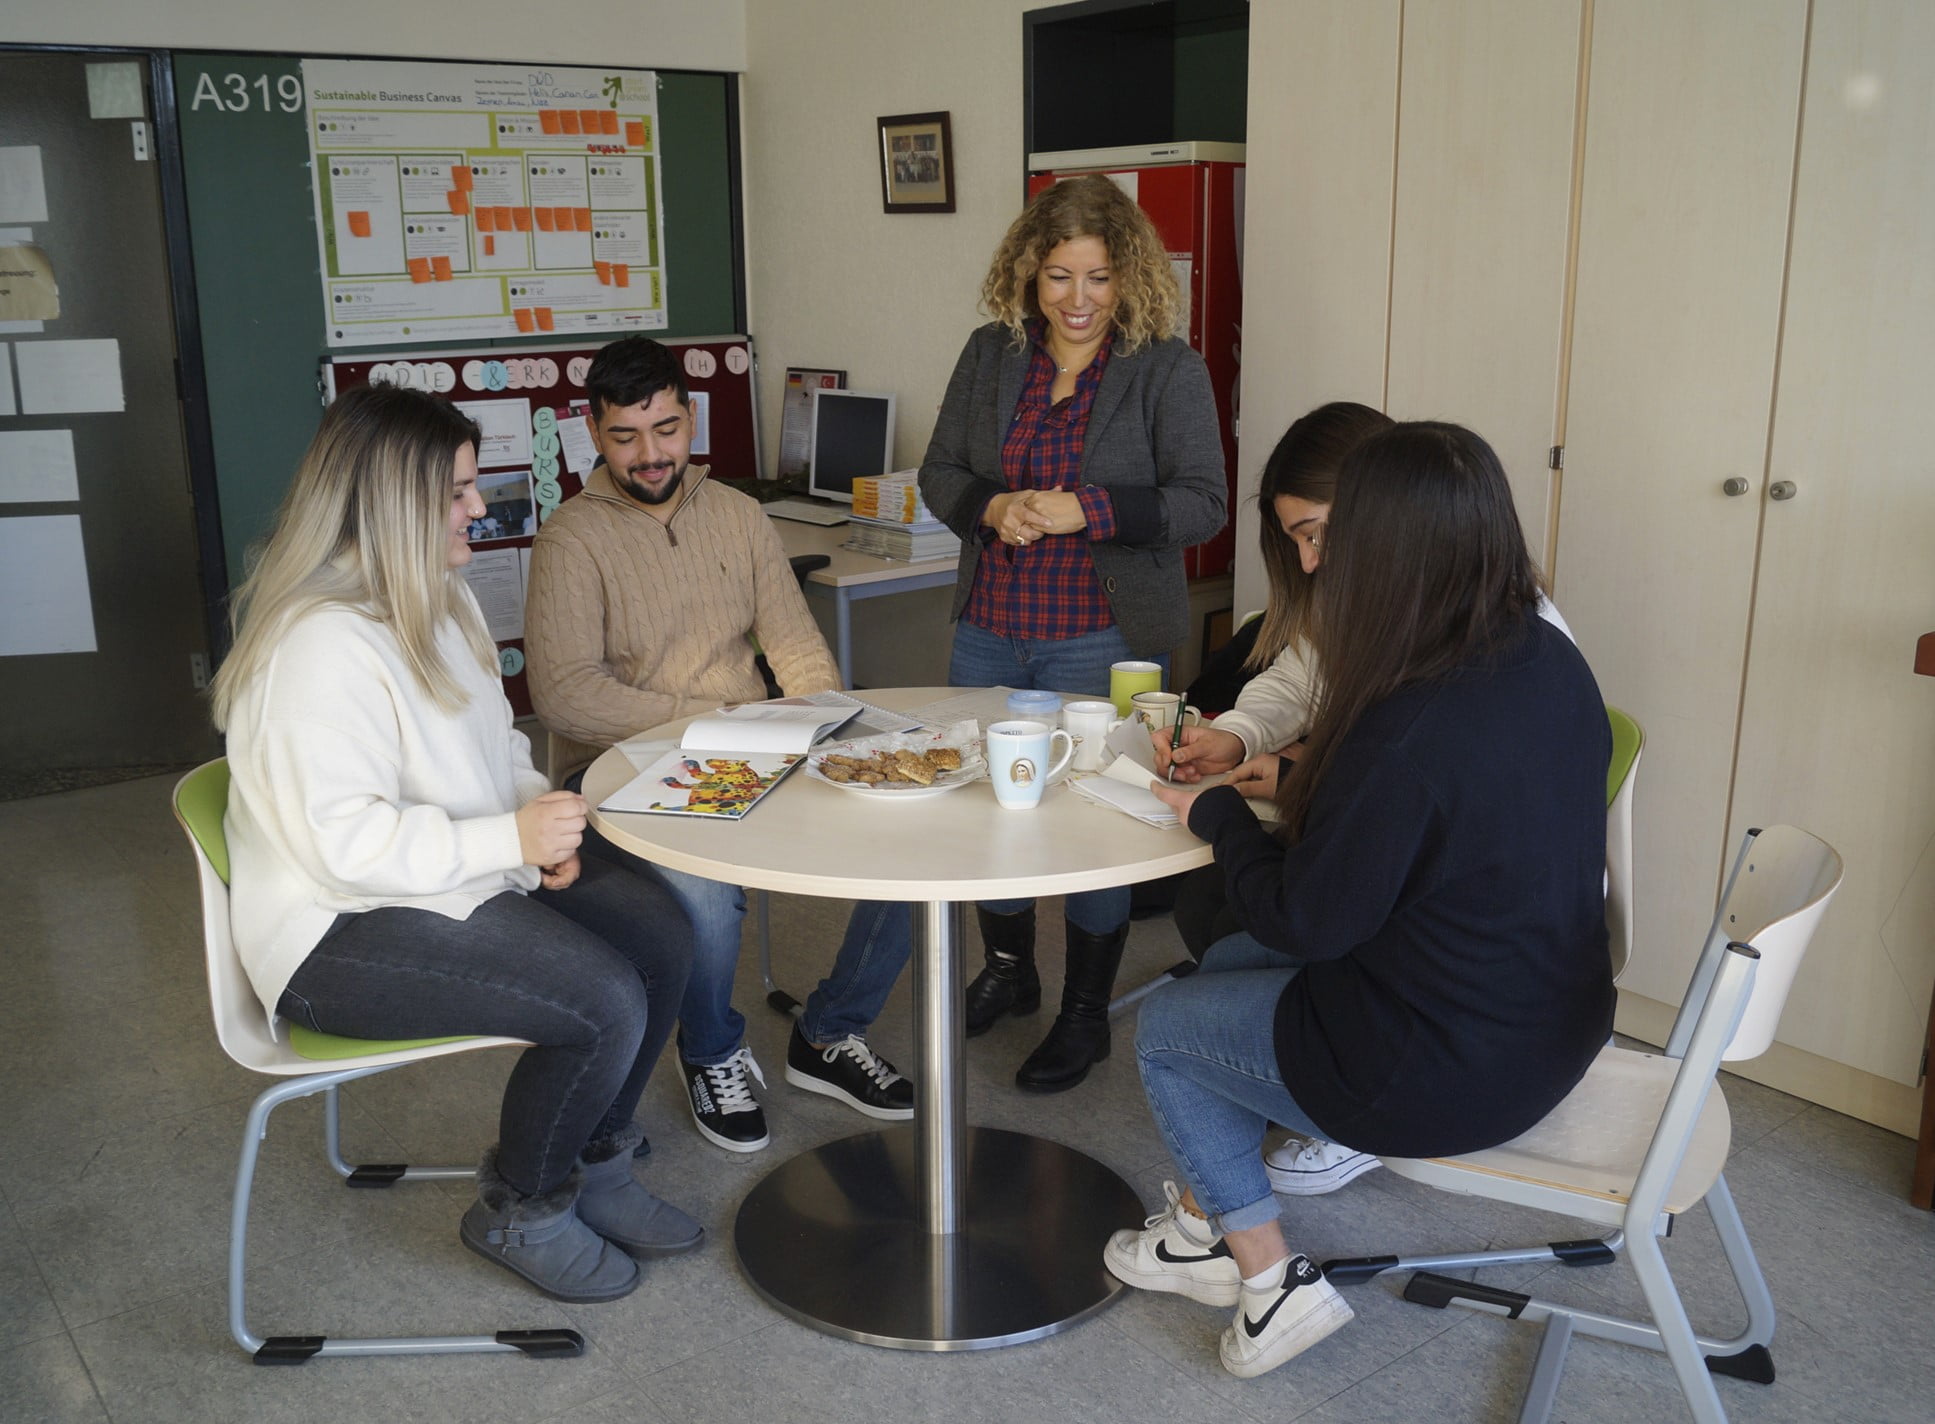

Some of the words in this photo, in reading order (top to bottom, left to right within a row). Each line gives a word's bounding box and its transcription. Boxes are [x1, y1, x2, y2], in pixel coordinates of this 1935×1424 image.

[191, 72, 303, 113] A319
[313, 89, 377, 101] Sustainable
[379, 91, 425, 102] Business
[426, 92, 462, 103] Canvas
[538, 411, 555, 511] BURS
[503, 654, 514, 669] A
